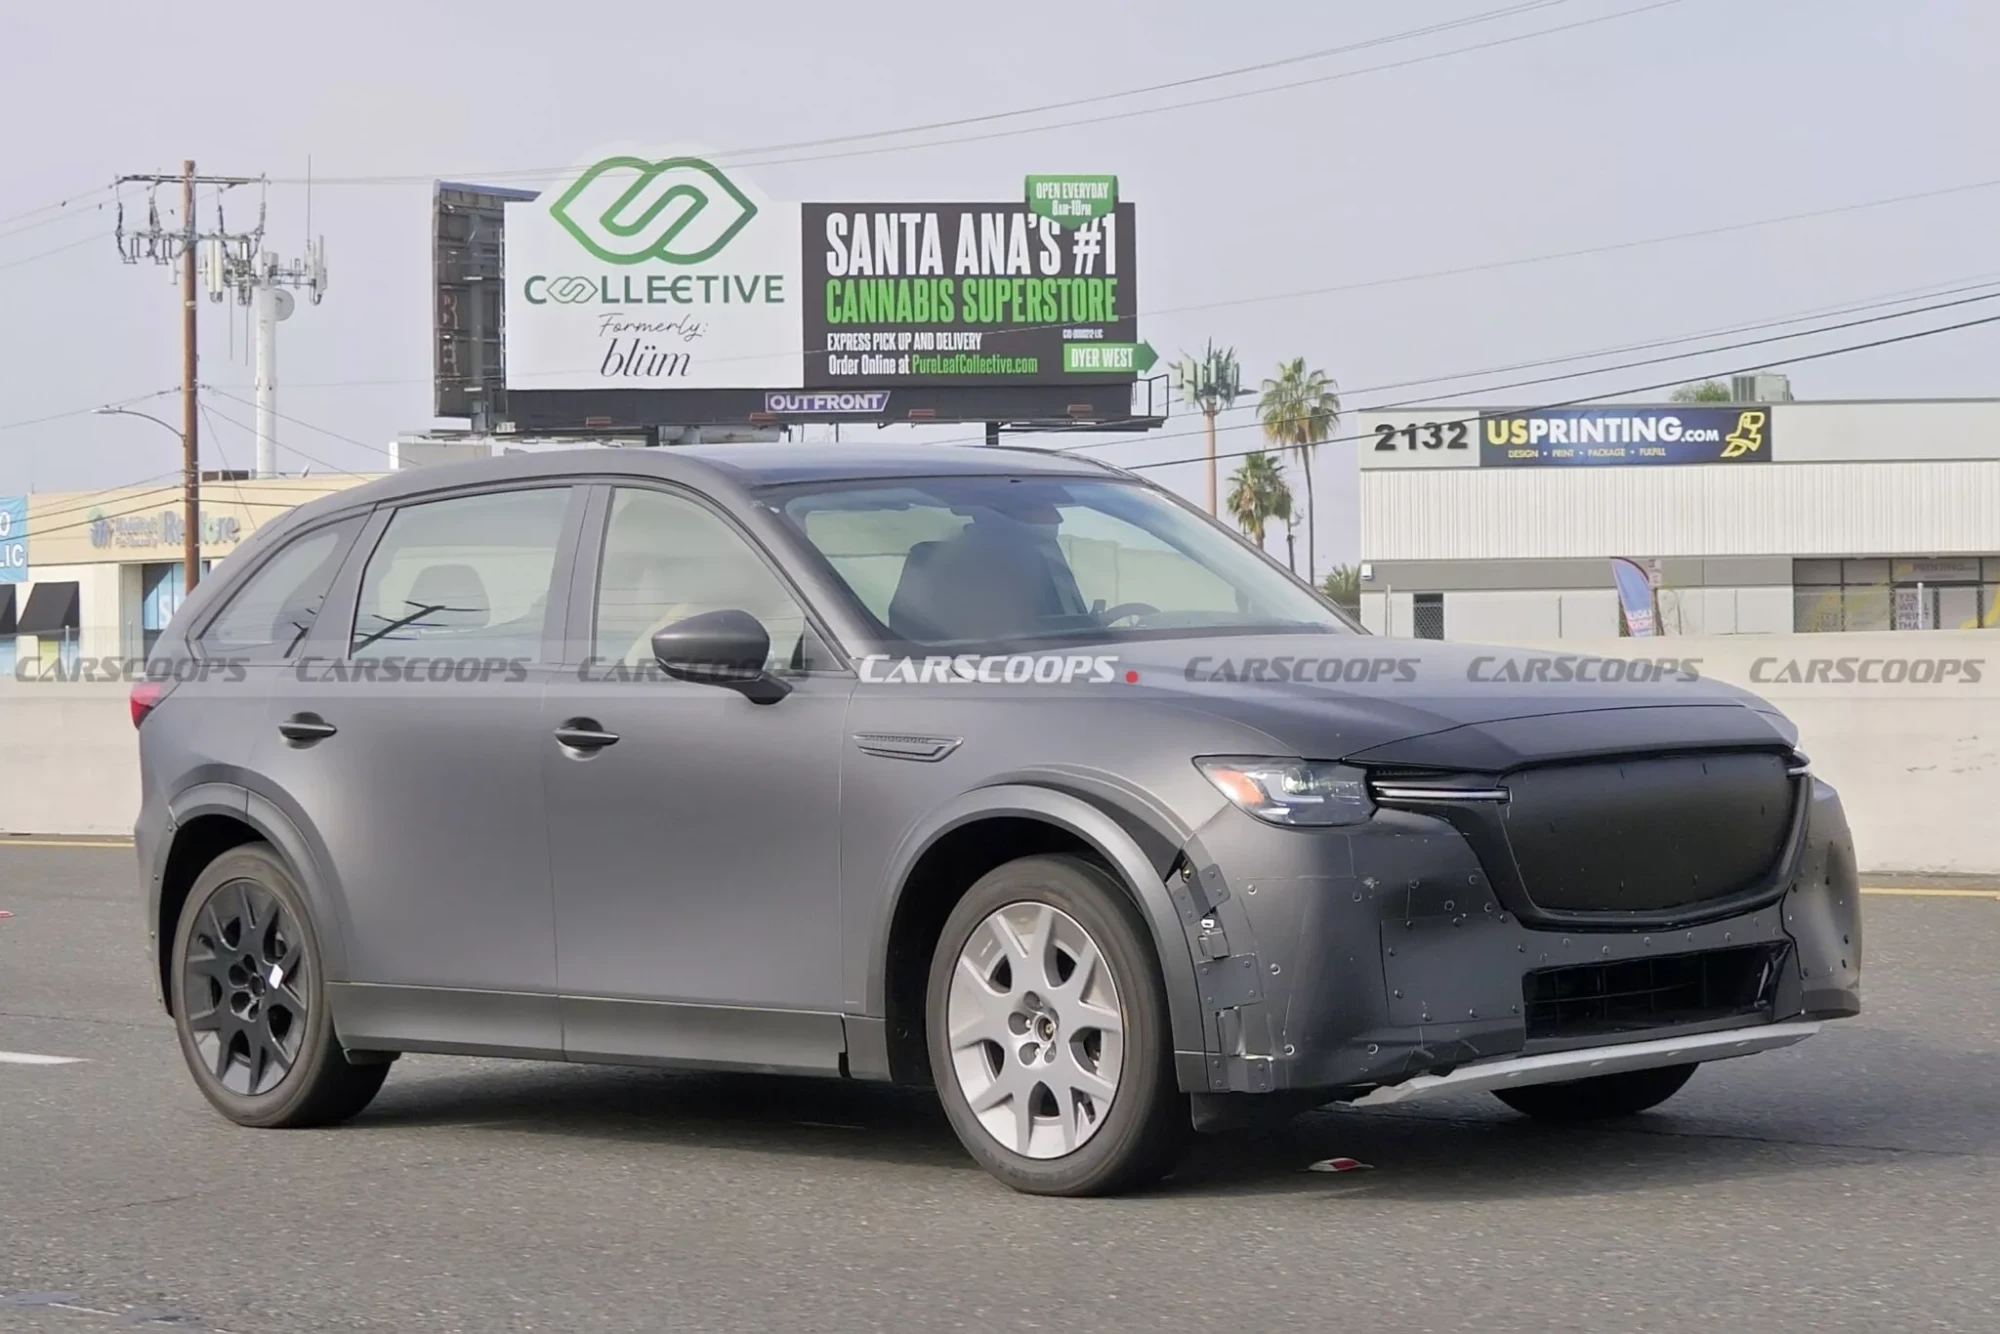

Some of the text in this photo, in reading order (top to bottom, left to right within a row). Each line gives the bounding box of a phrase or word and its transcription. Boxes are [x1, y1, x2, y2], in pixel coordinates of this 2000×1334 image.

[1036, 182, 1109, 199] OPEN EVERYDAY
[826, 212, 1117, 276] SANTA ANA'S #1
[826, 278, 1119, 323] CANNABIS SUPERSTORE
[827, 332, 982, 351] EXPRESS PICK UP AND DELIVERY
[600, 338, 690, 377] blüm
[828, 354, 1038, 375] Order Online at PureLeafCollective.com
[1071, 348, 1133, 368] DYER WEST
[770, 393, 883, 411] OUTFRONT
[1374, 422, 1469, 452] 2132
[1508, 447, 1666, 458] DESIGN PRINT PACKAGE FULFILL
